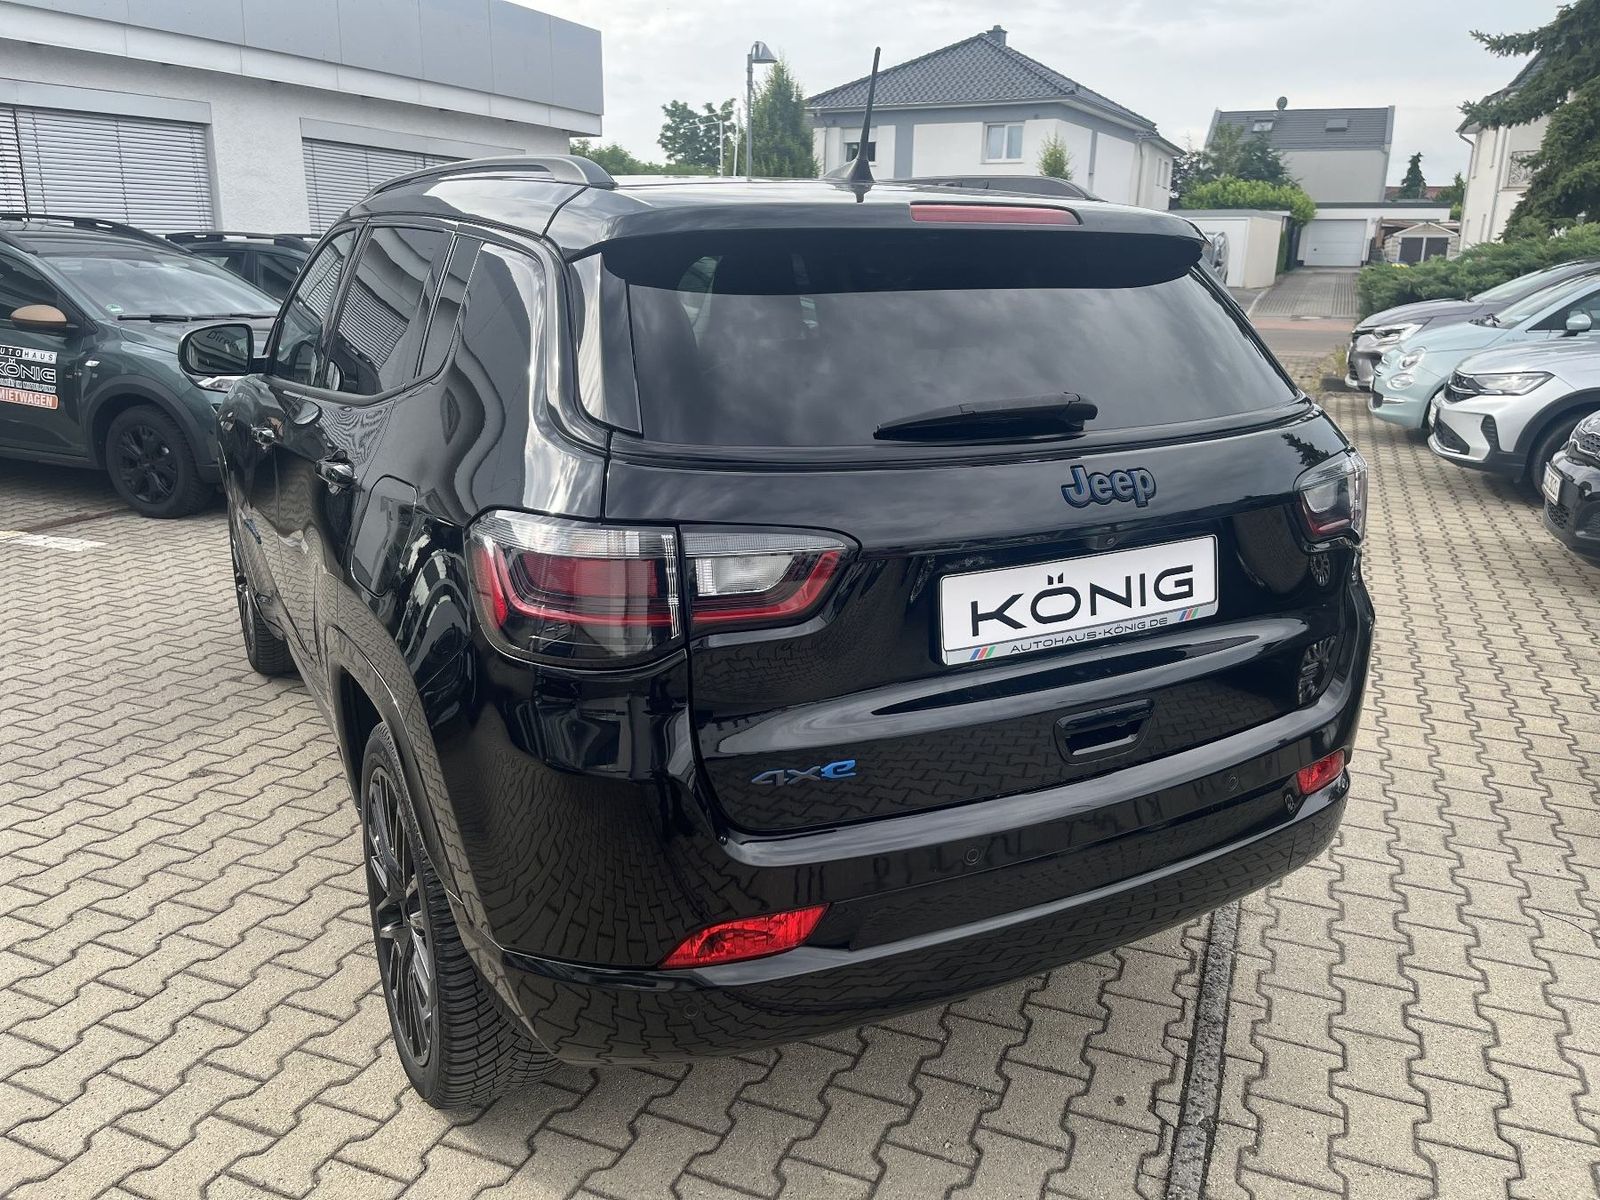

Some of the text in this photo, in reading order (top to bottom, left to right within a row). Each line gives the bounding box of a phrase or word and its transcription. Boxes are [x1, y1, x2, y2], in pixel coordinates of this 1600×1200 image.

[0, 347, 54, 361] UTOHAUS
[1061, 465, 1156, 508] Jeep
[971, 565, 1194, 637] KÖNIG
[1009, 617, 1168, 654] AUTOHAUS-KÖNIG.DE
